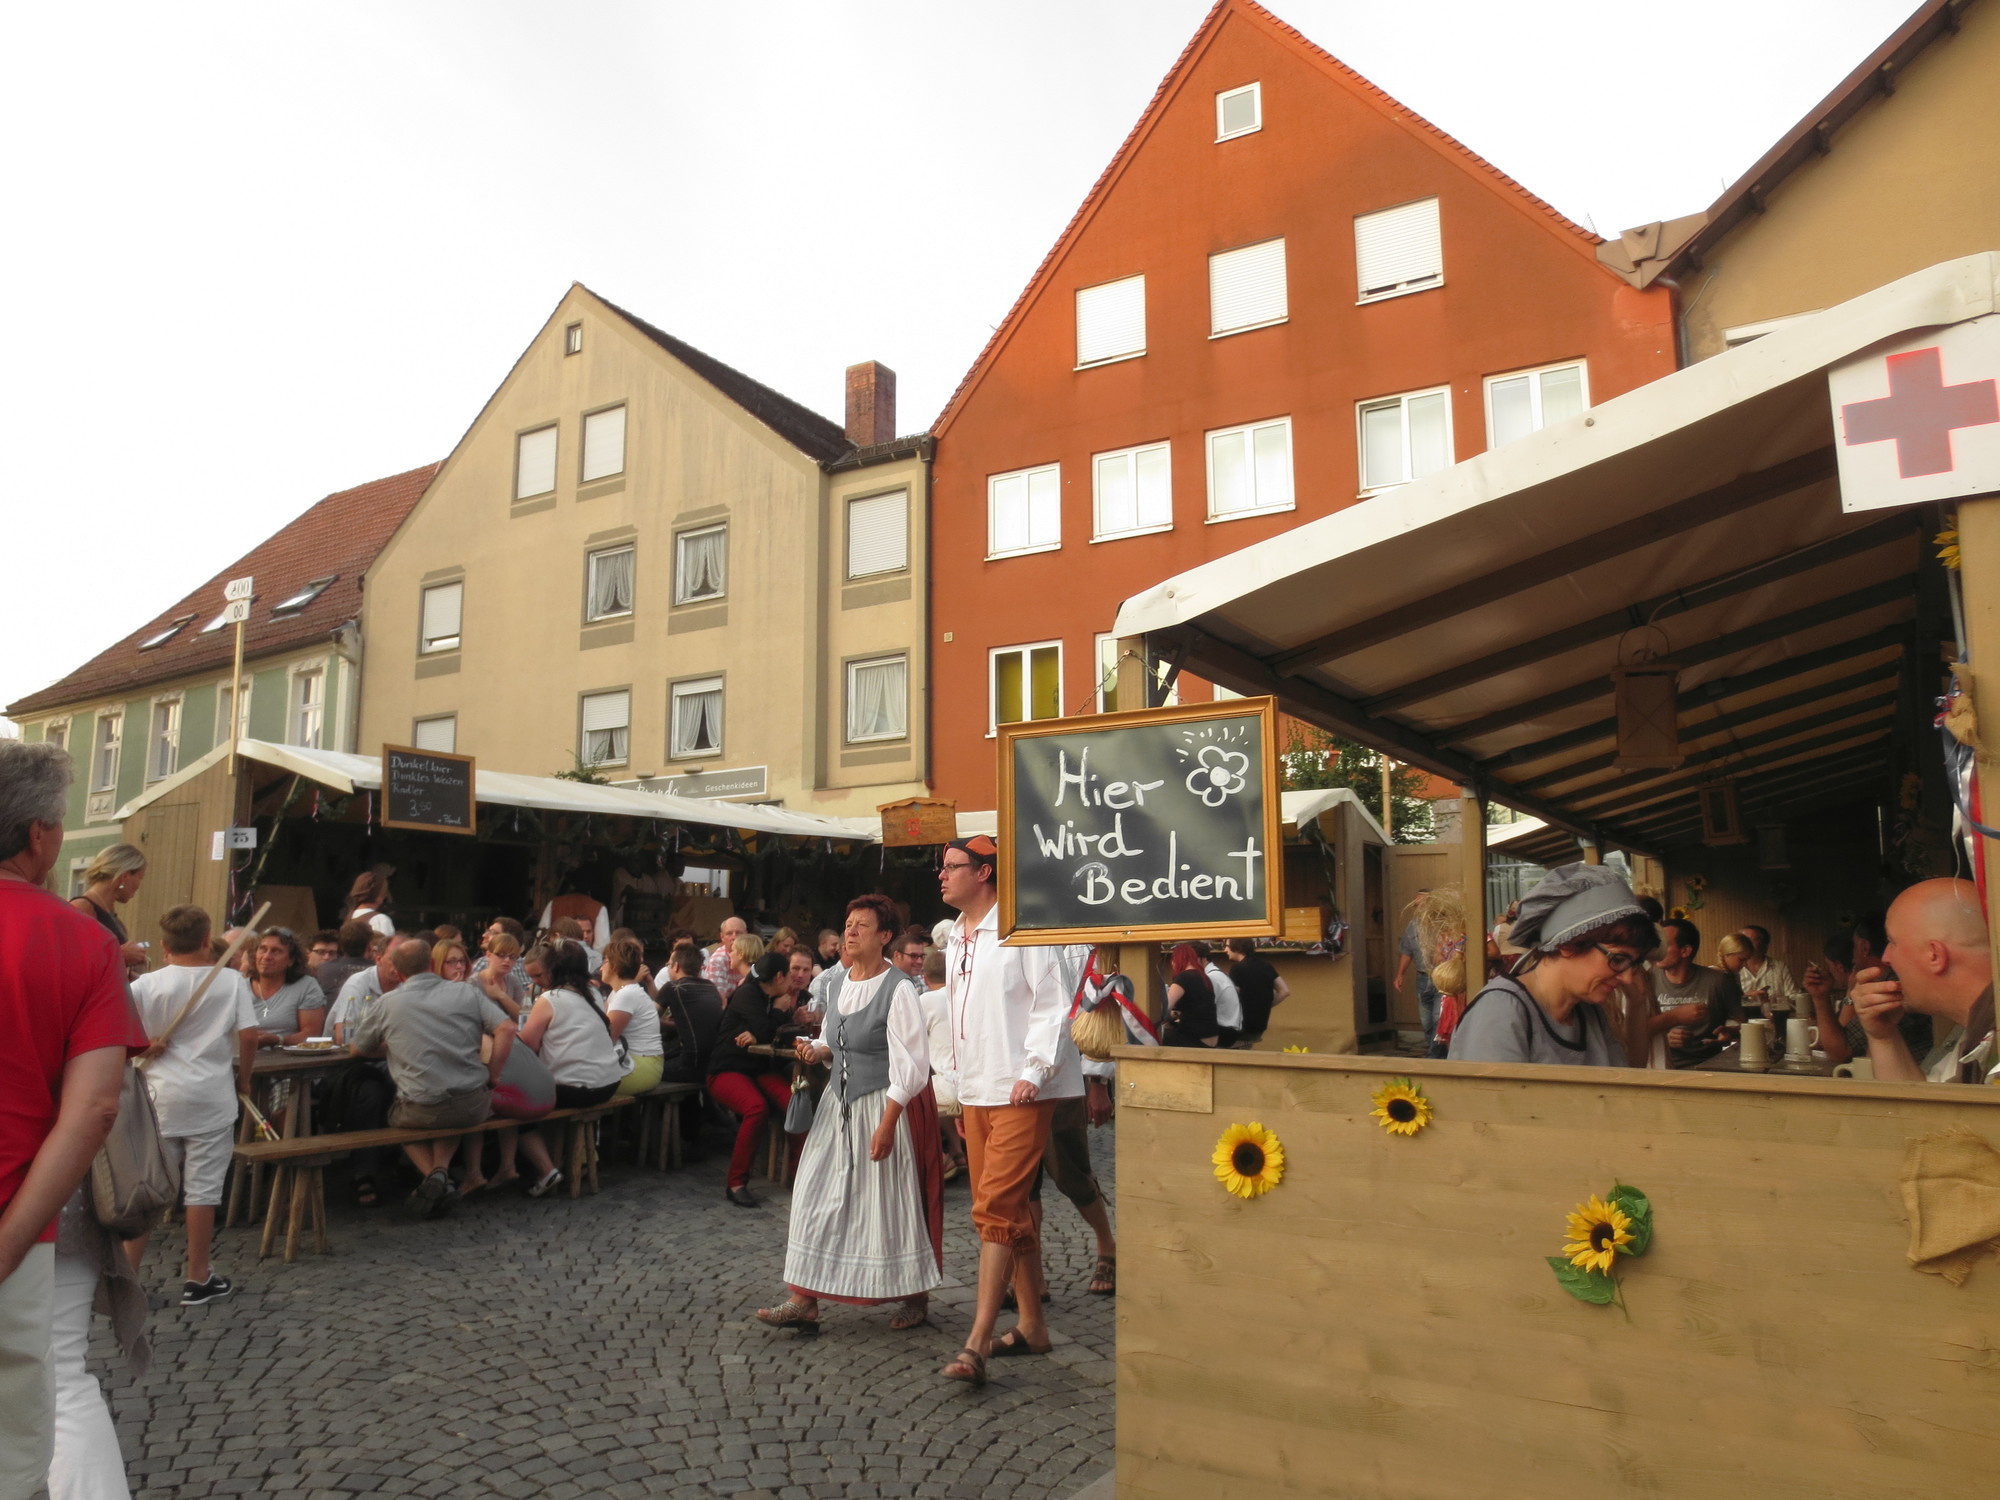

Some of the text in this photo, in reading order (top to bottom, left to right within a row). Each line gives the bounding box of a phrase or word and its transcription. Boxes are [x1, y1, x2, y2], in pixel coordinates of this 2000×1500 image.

[705, 781, 758, 792] Geschenkideen
[1054, 745, 1165, 809] Hier
[1073, 830, 1263, 905] Bedient
